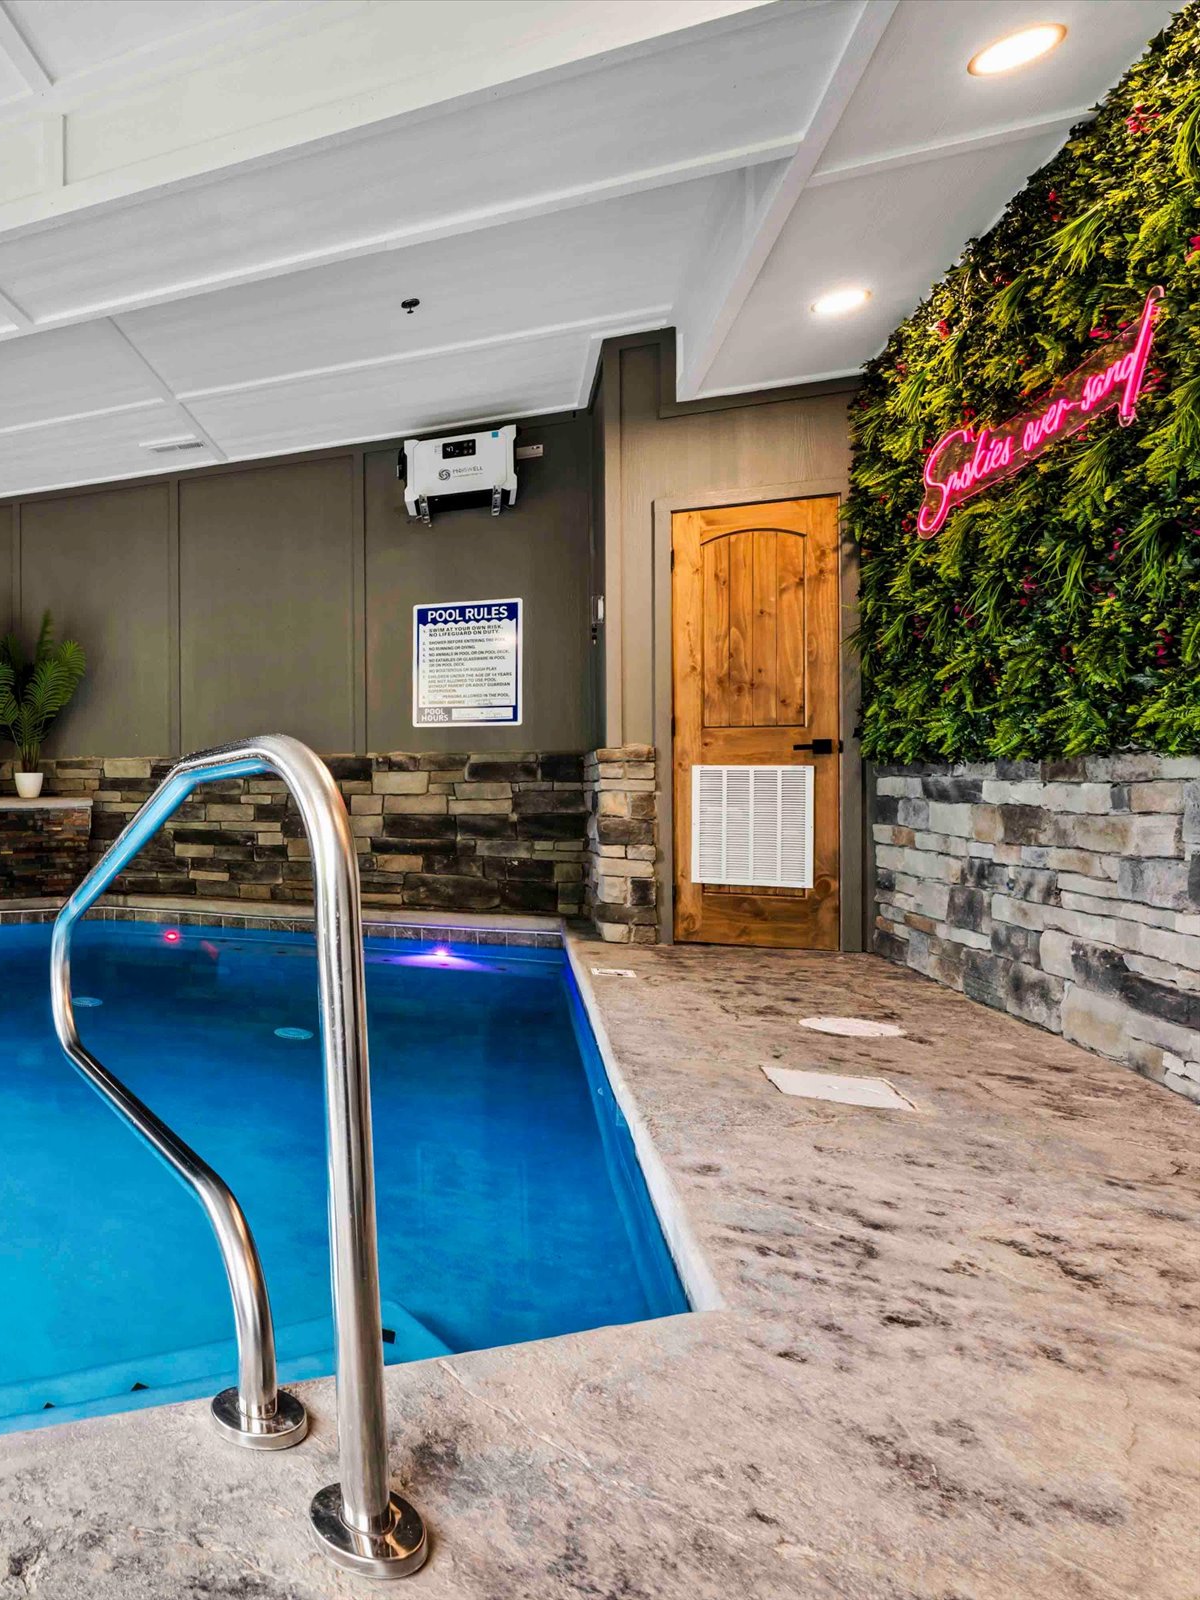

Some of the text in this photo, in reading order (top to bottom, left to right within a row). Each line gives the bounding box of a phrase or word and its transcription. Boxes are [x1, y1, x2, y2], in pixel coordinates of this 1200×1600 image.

[1022, 398, 1072, 452] over
[428, 606, 507, 622] POOL RULES
